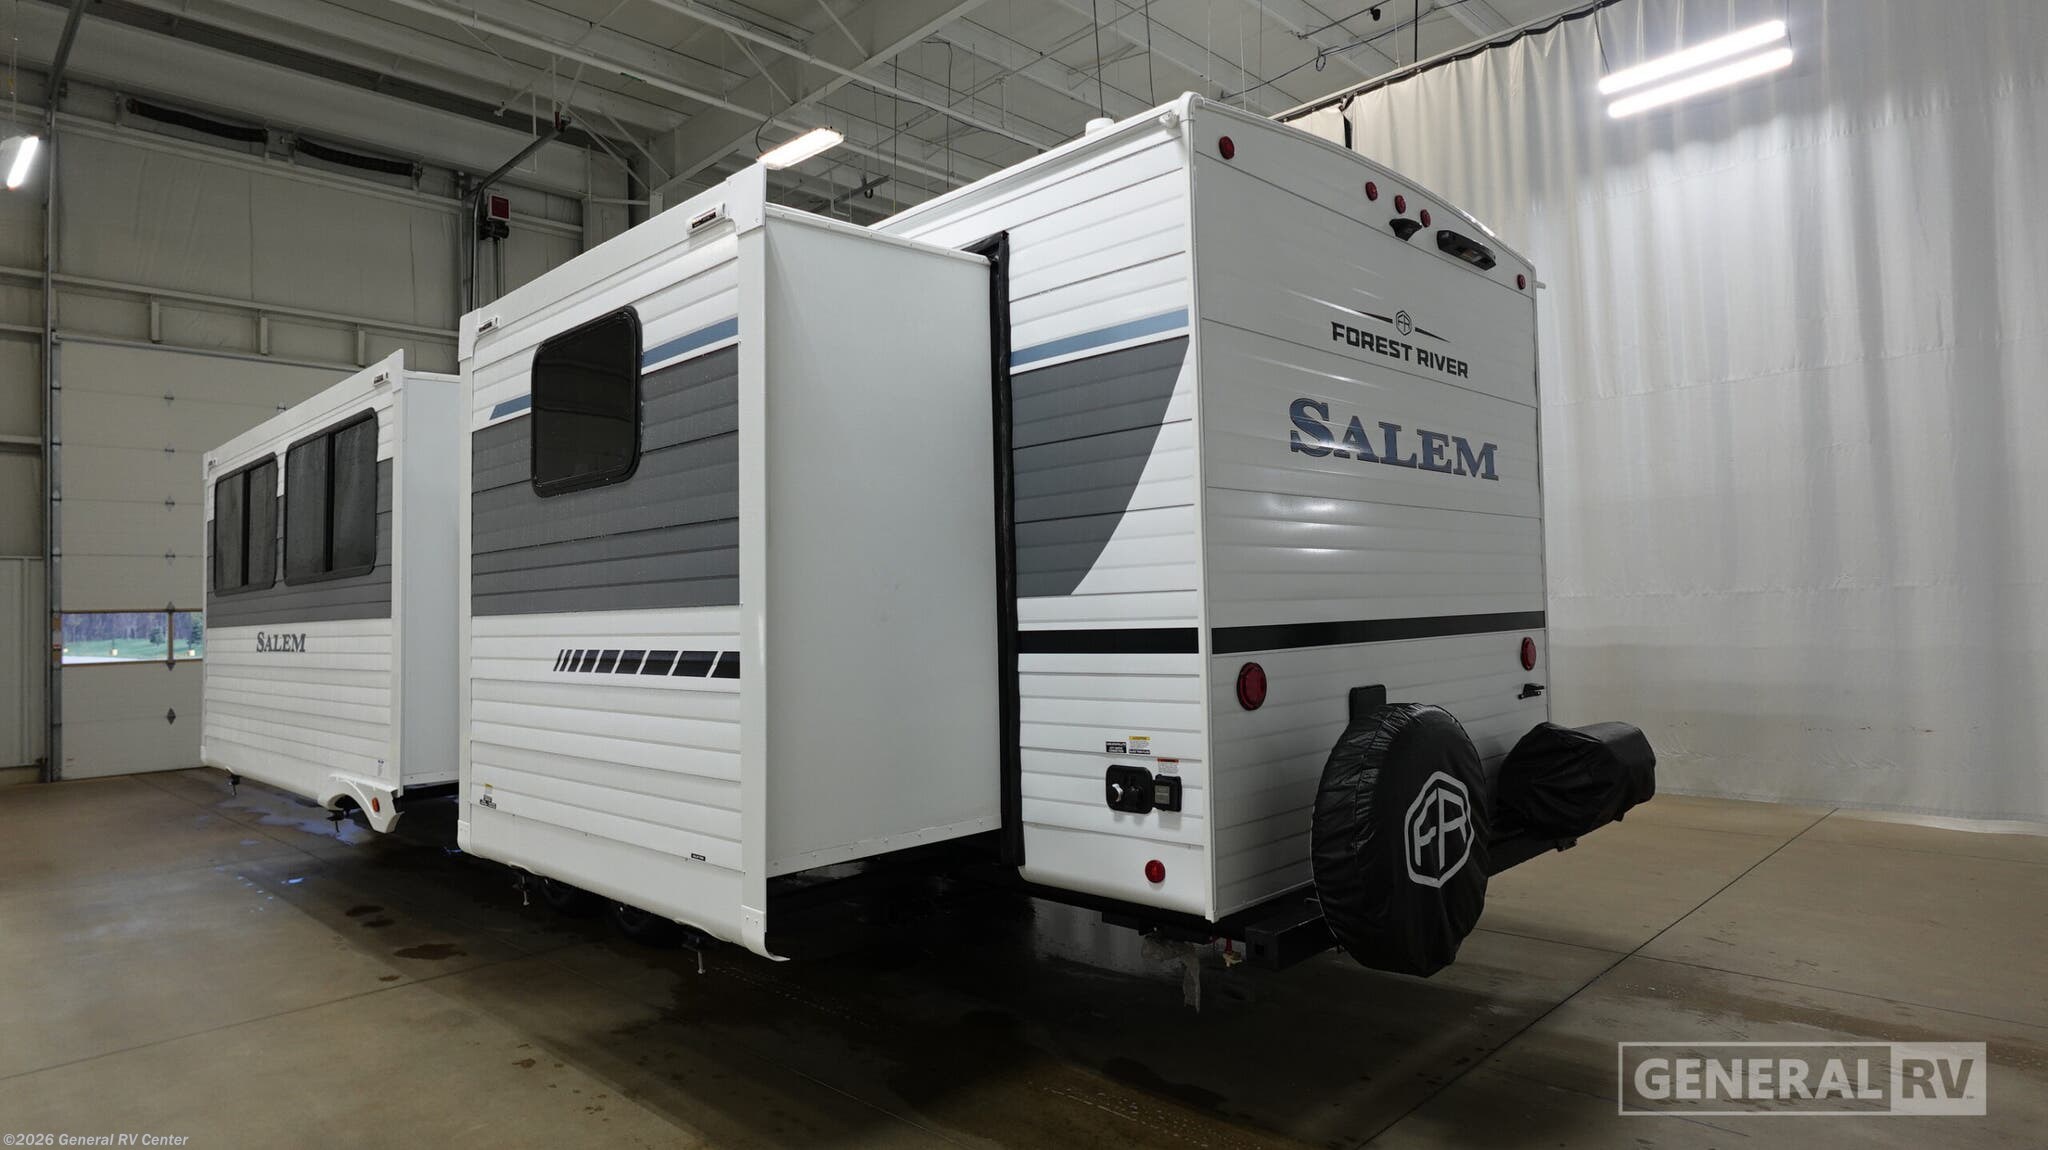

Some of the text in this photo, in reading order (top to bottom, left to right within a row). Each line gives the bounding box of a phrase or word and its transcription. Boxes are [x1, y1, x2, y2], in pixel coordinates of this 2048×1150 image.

[1331, 321, 1469, 379] FOREST RIVER
[1289, 397, 1499, 481] SALEM
[256, 631, 307, 653] SALEM
